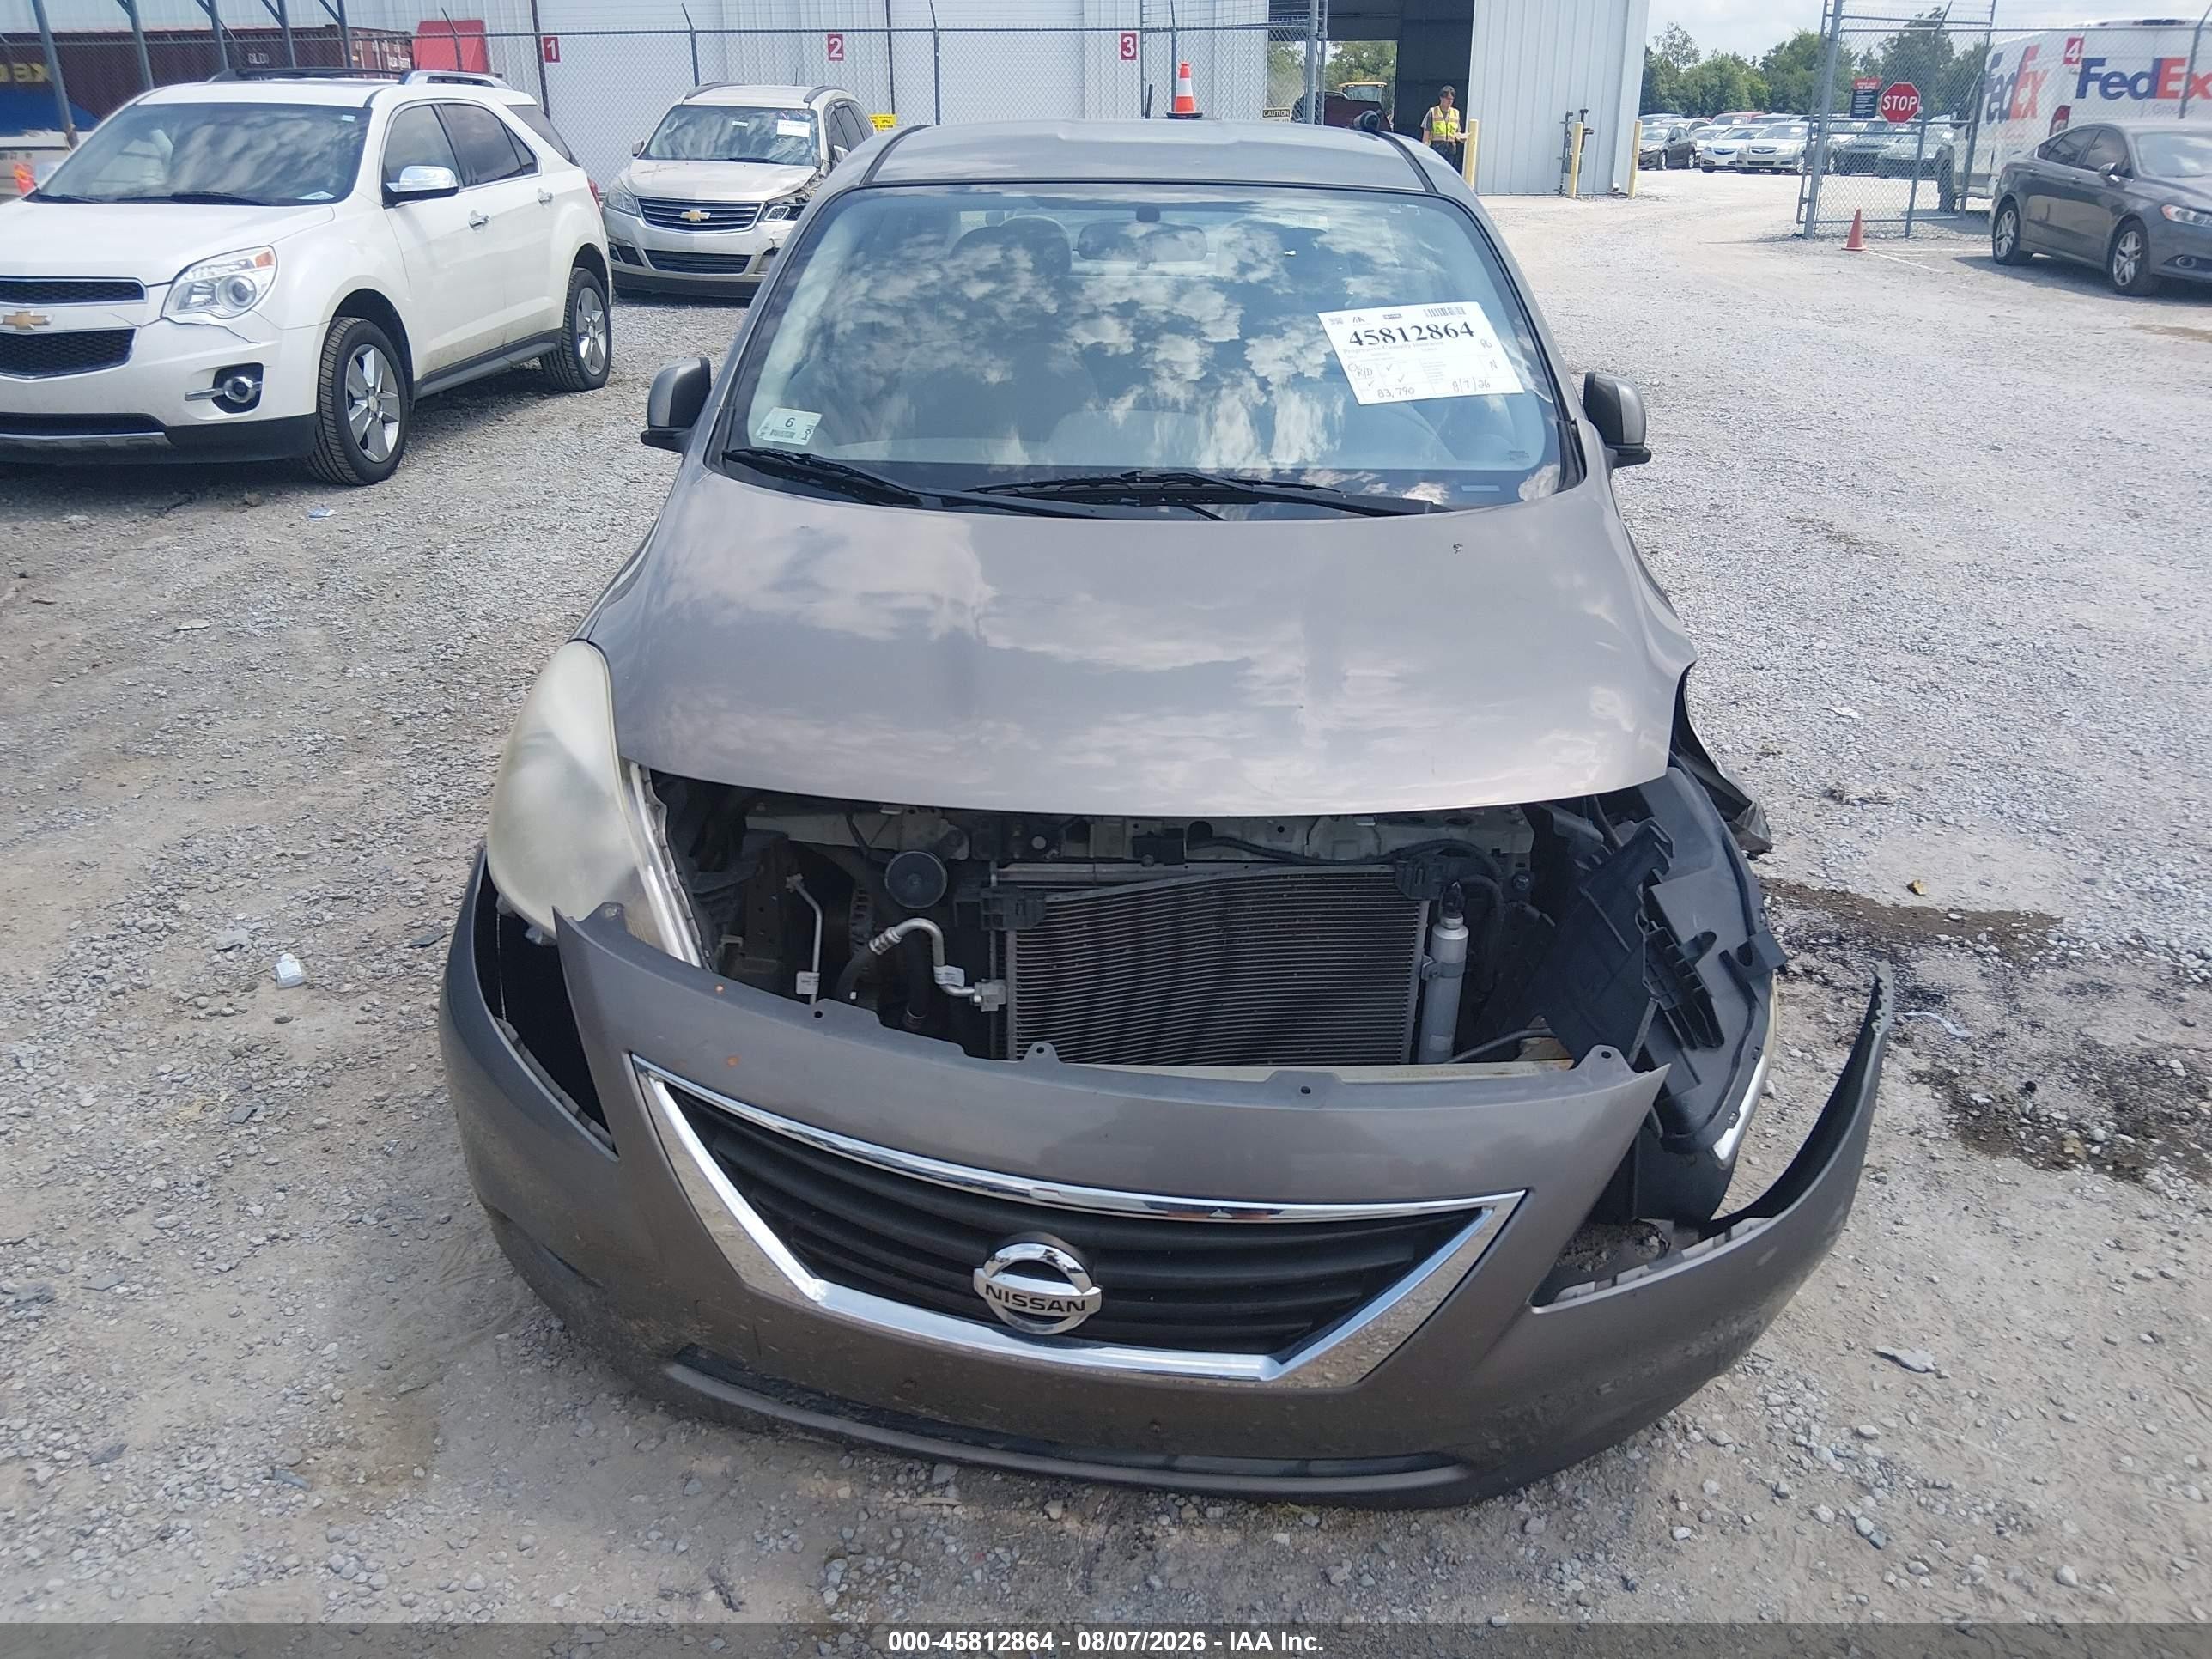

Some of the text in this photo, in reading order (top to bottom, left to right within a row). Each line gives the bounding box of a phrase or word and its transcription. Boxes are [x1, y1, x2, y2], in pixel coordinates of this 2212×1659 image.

[547, 40, 556, 59] 1
[830, 37, 842, 58] 2
[1122, 36, 1135, 58] 3
[2066, 43, 2081, 63] 4
[2075, 57, 2212, 100] FedEx
[1881, 95, 1917, 111] STOP
[1349, 321, 1474, 346] 45812864
[1376, 386, 1415, 398] 83,790
[785, 417, 796, 428] 6
[985, 1283, 1086, 1313] NISSAN
